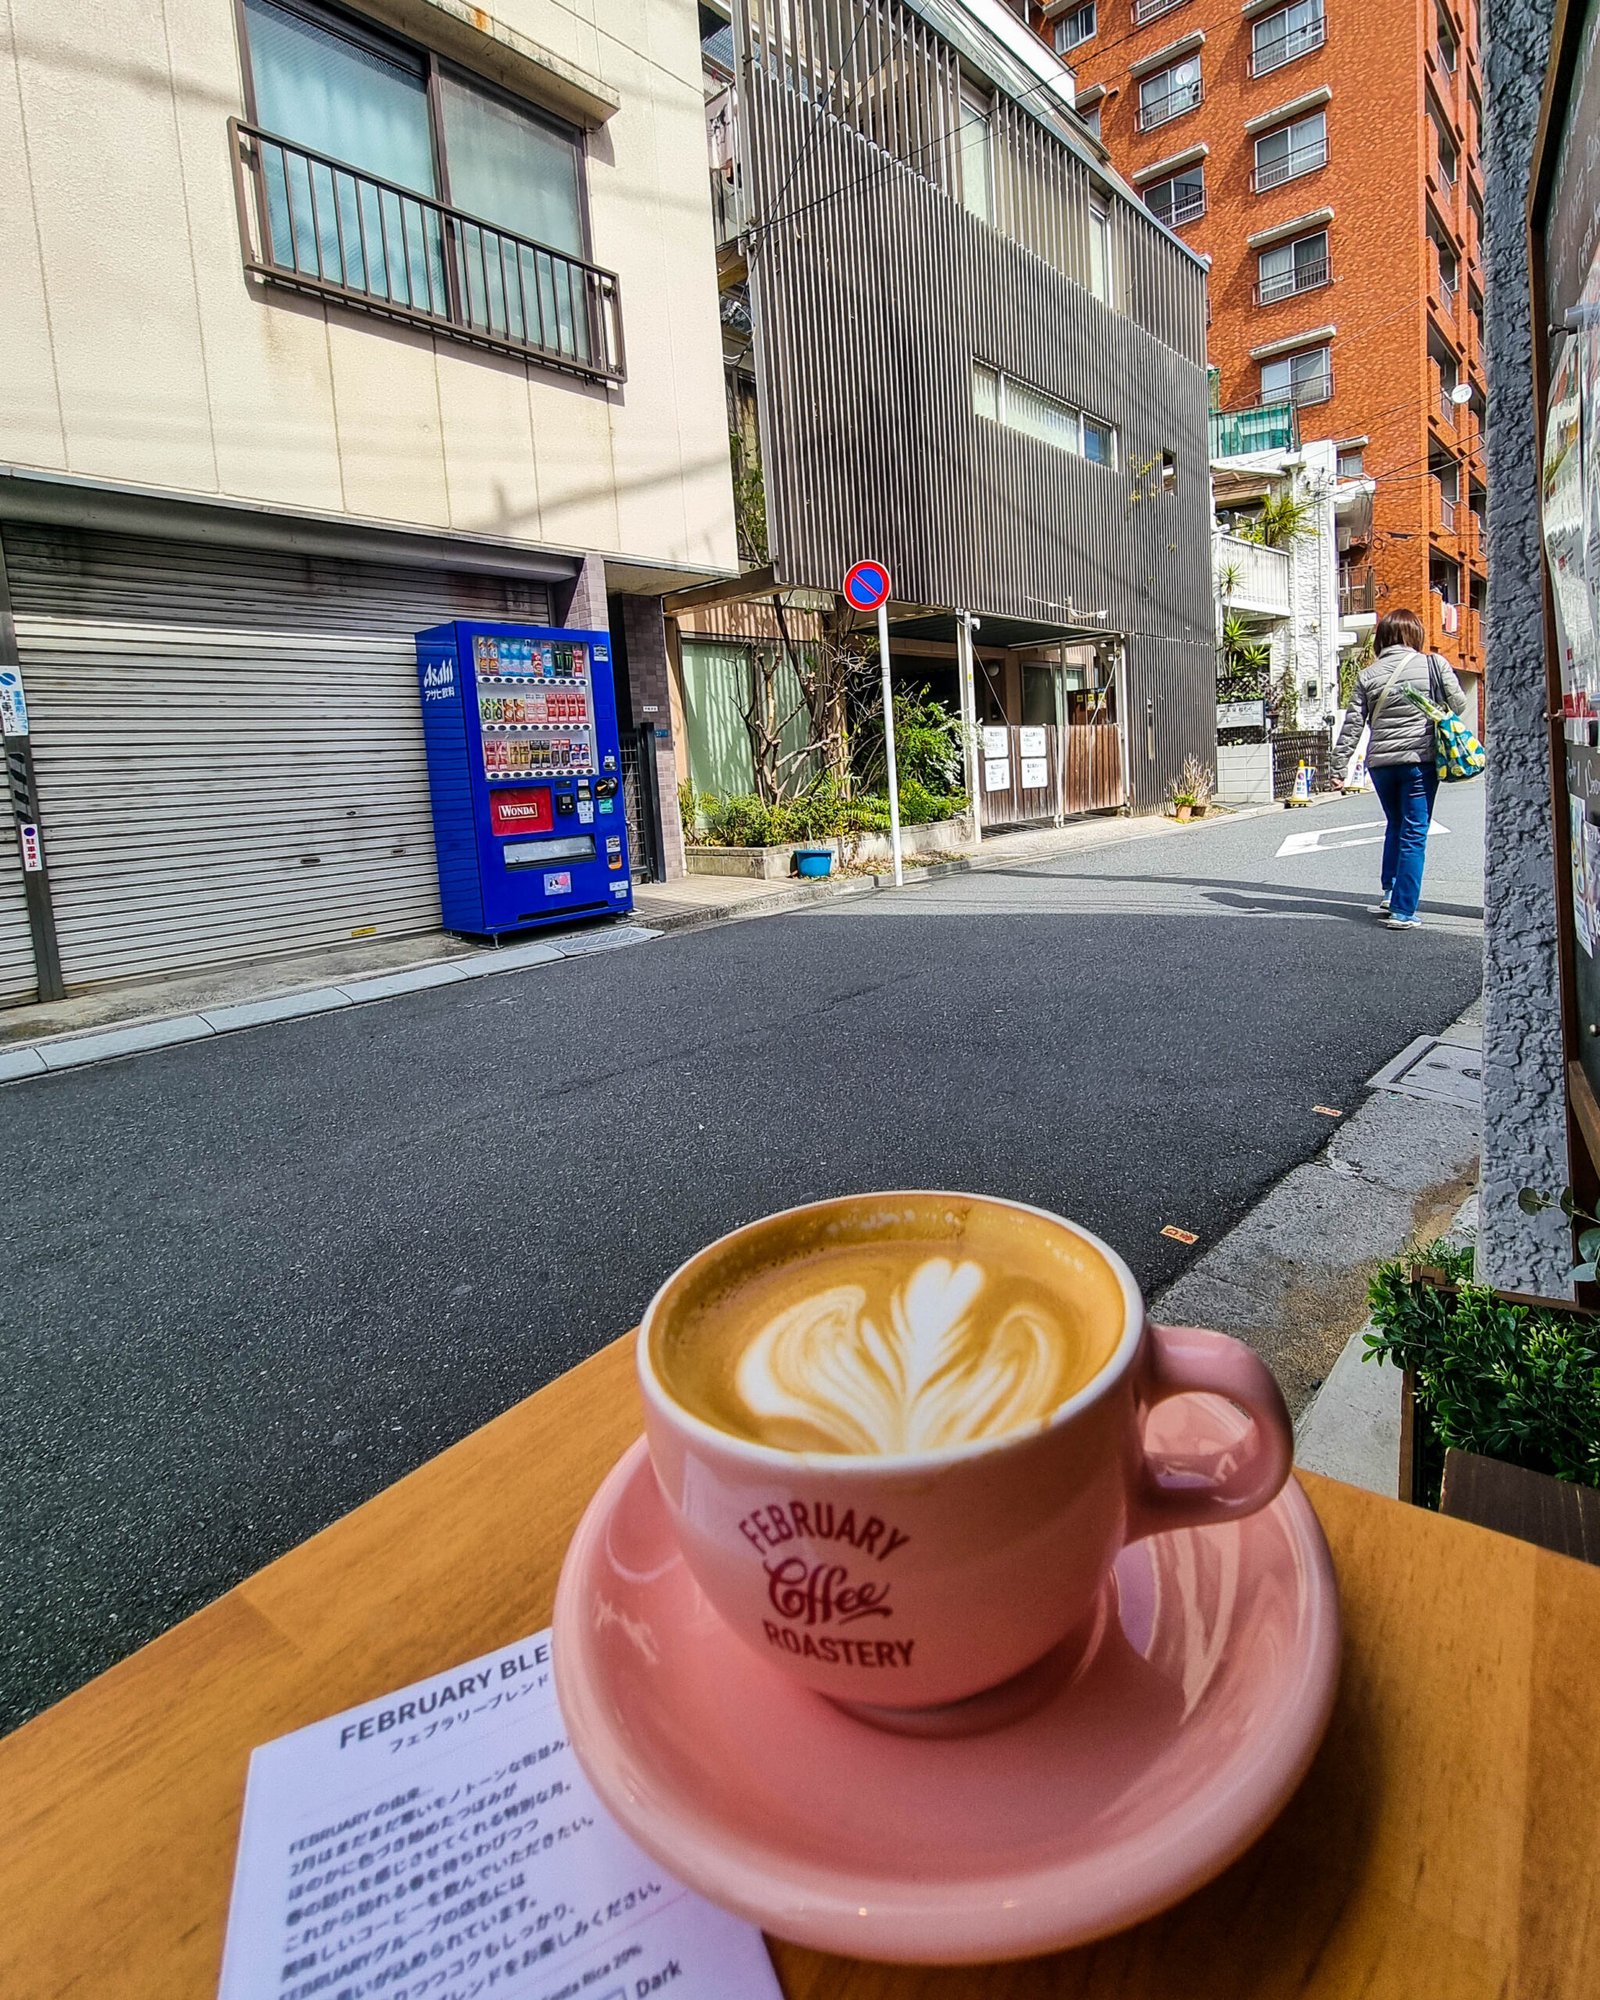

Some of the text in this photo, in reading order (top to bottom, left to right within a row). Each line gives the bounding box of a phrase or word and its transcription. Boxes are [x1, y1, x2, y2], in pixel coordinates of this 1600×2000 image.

[424, 659, 453, 687] Asahi
[425, 687, 454, 702] アサヒ飲料
[500, 804, 535, 817] WONDA
[739, 1502, 909, 1560] FEBRUARY
[763, 1556, 893, 1626] Coffee
[763, 1621, 914, 1668] ROASTERY
[339, 1643, 552, 1749] FEBRUARY BLE
[389, 1672, 551, 1755] フェブラリーブレンド
[290, 1737, 572, 1877] 2月はまだまだ寒いモノトーンな街並み
[288, 1808, 372, 1855] FEBRUARY
[636, 1959, 682, 1999] Dark
